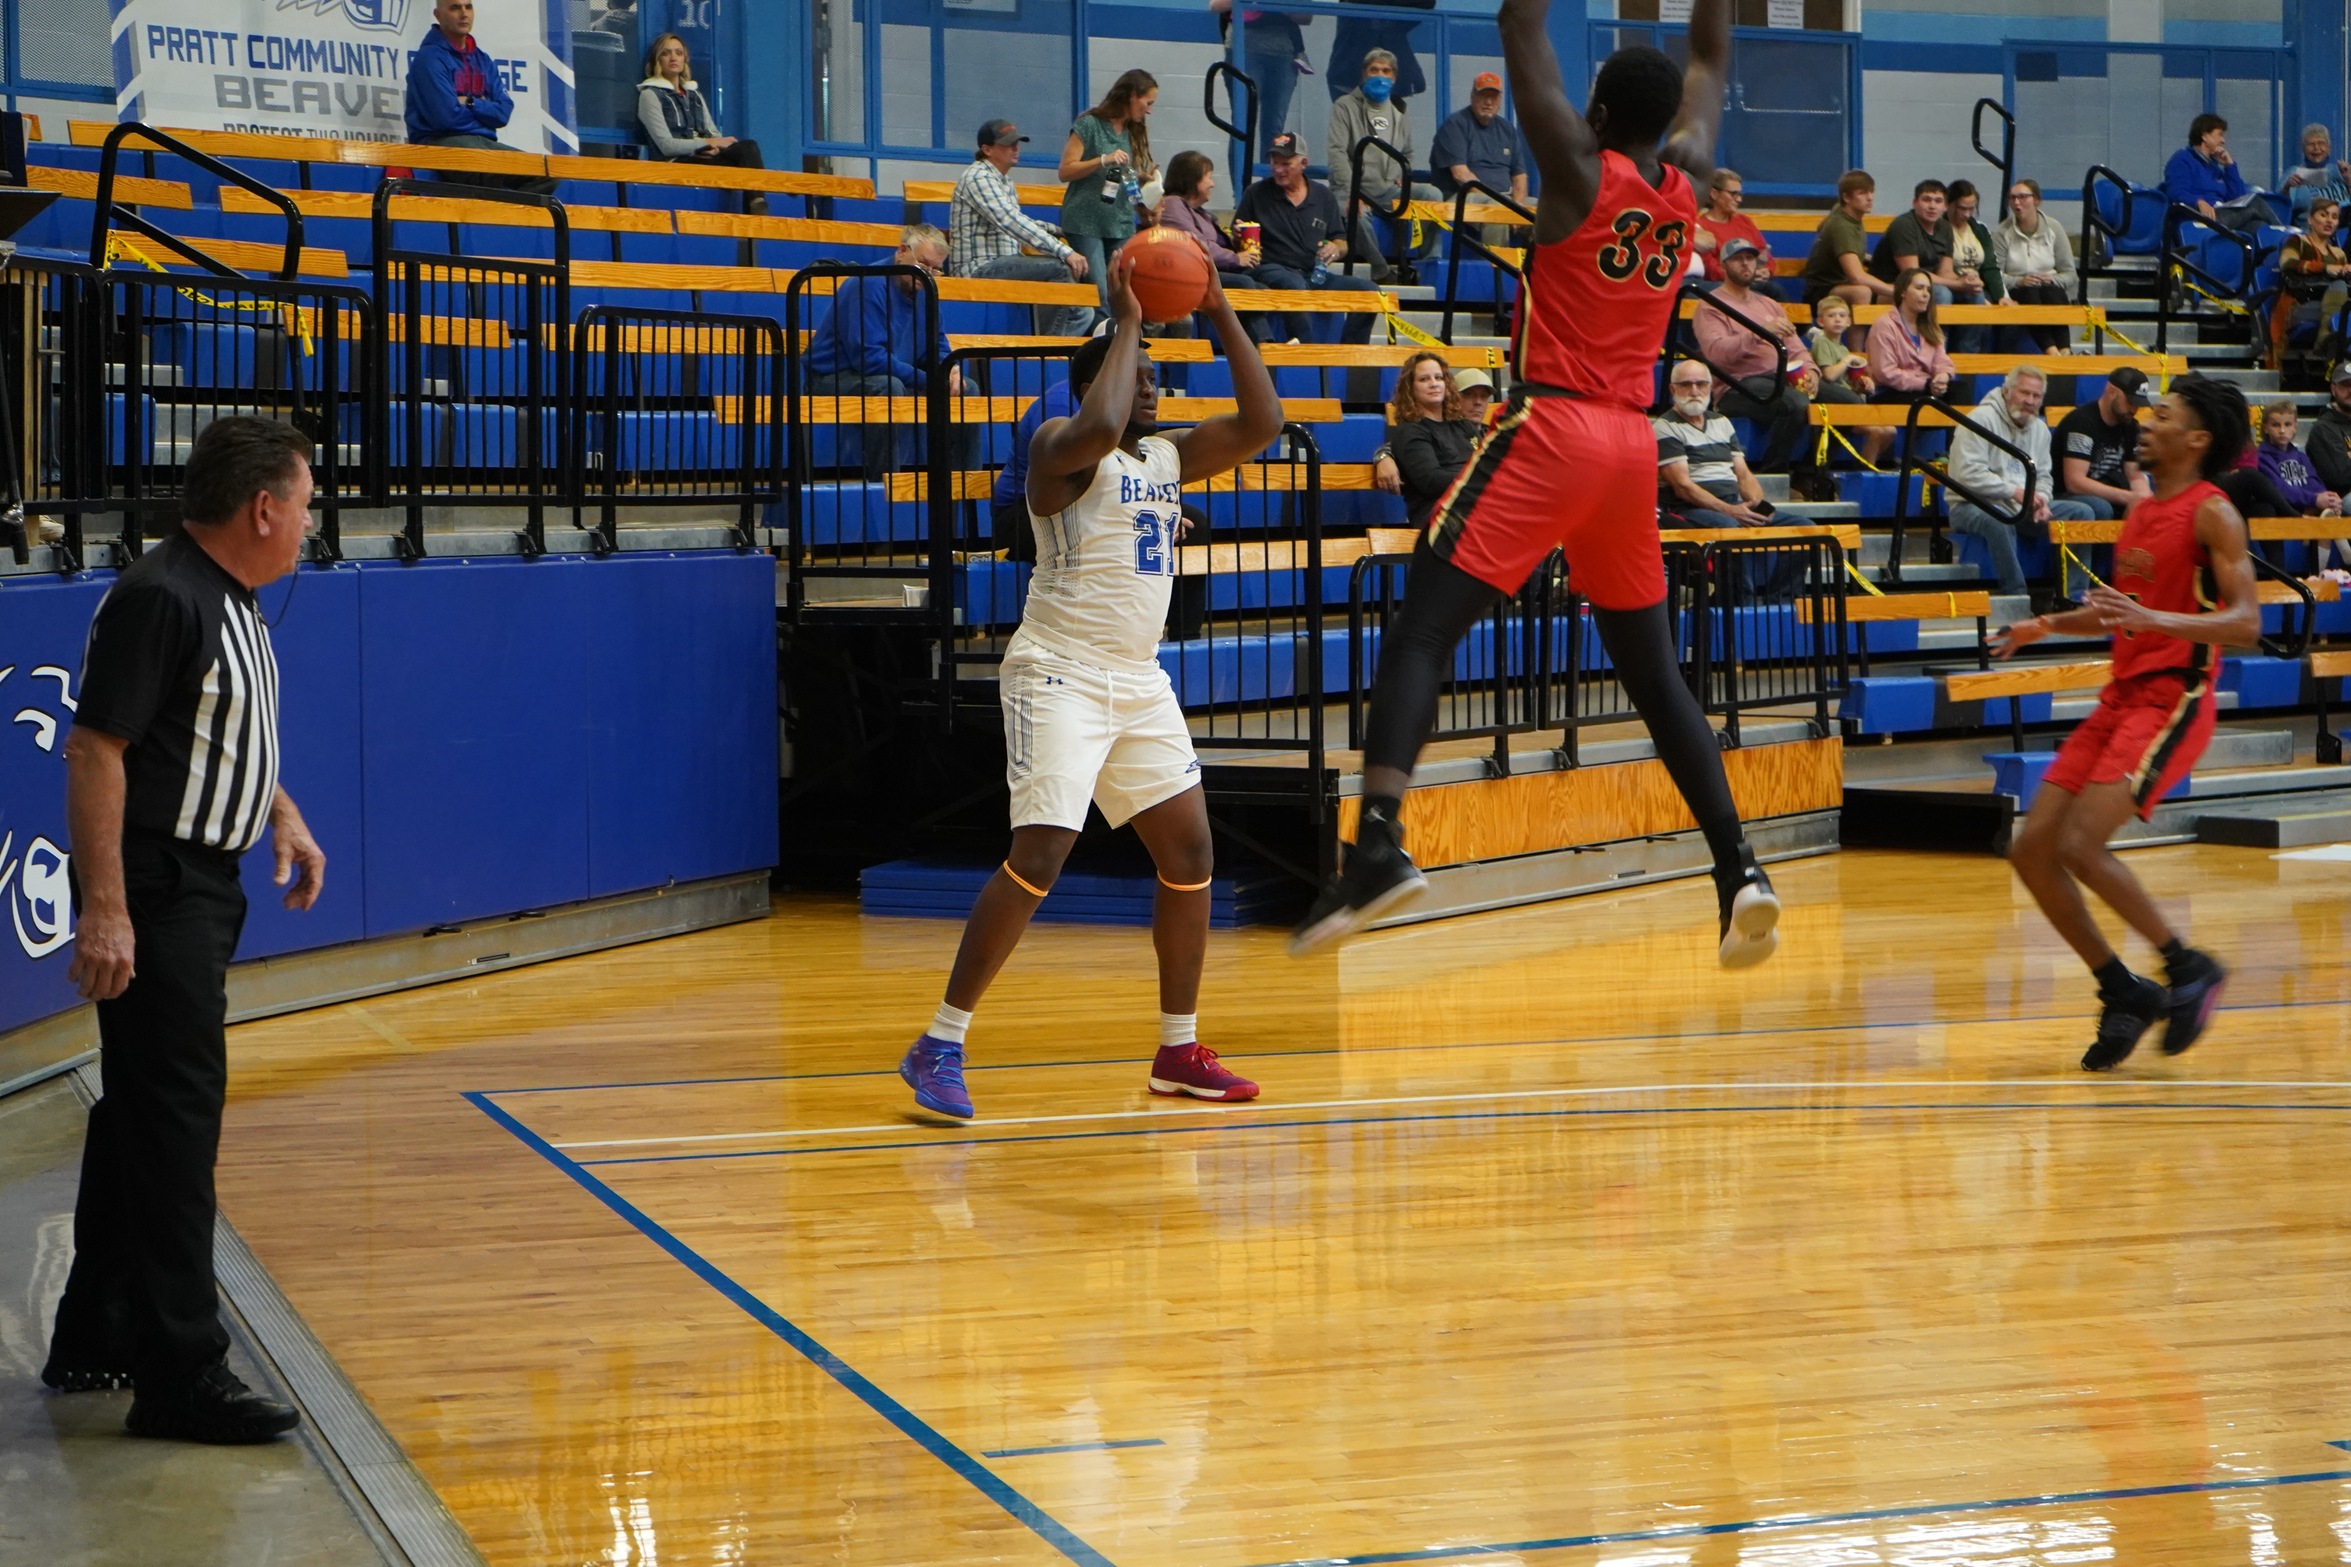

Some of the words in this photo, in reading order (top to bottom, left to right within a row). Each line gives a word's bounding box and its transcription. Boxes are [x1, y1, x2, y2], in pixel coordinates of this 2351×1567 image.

[147, 24, 238, 66] PRATT
[247, 34, 398, 80] COMMUNITY
[214, 74, 407, 121] BEAVE
[1597, 208, 1688, 291] 33
